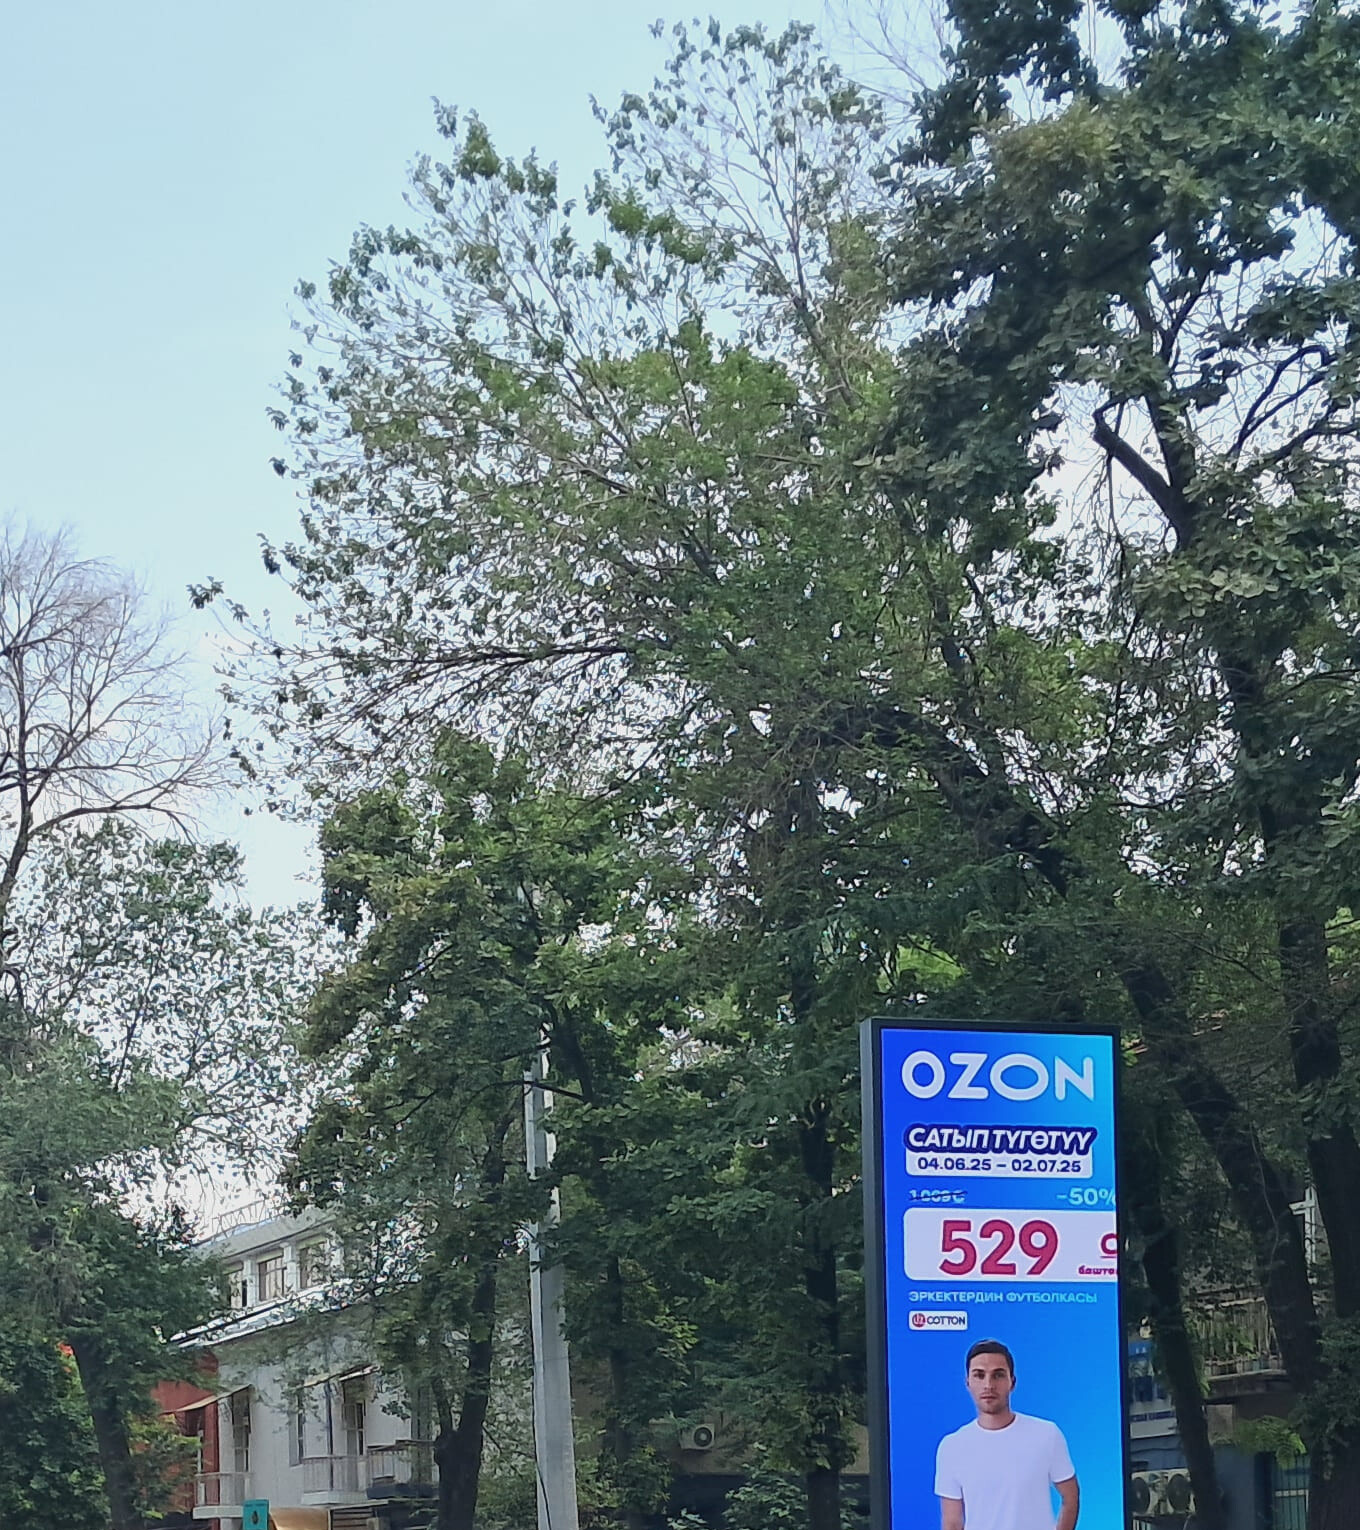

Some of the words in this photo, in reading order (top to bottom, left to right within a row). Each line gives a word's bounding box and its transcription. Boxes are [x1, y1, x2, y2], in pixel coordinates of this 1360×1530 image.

[901, 1050, 1094, 1101] OZON
[908, 1127, 989, 1149] САТЫП
[917, 1157, 992, 1171] 04.06.25
[1011, 1159, 1081, 1173] 02.07.25
[939, 1219, 1059, 1276] 529
[1078, 1265, 1118, 1275] башта
[908, 1291, 1004, 1303] ЭРКЕКТЕРДИН
[1006, 1292, 1098, 1303] ФУТБОЛКАСЫ
